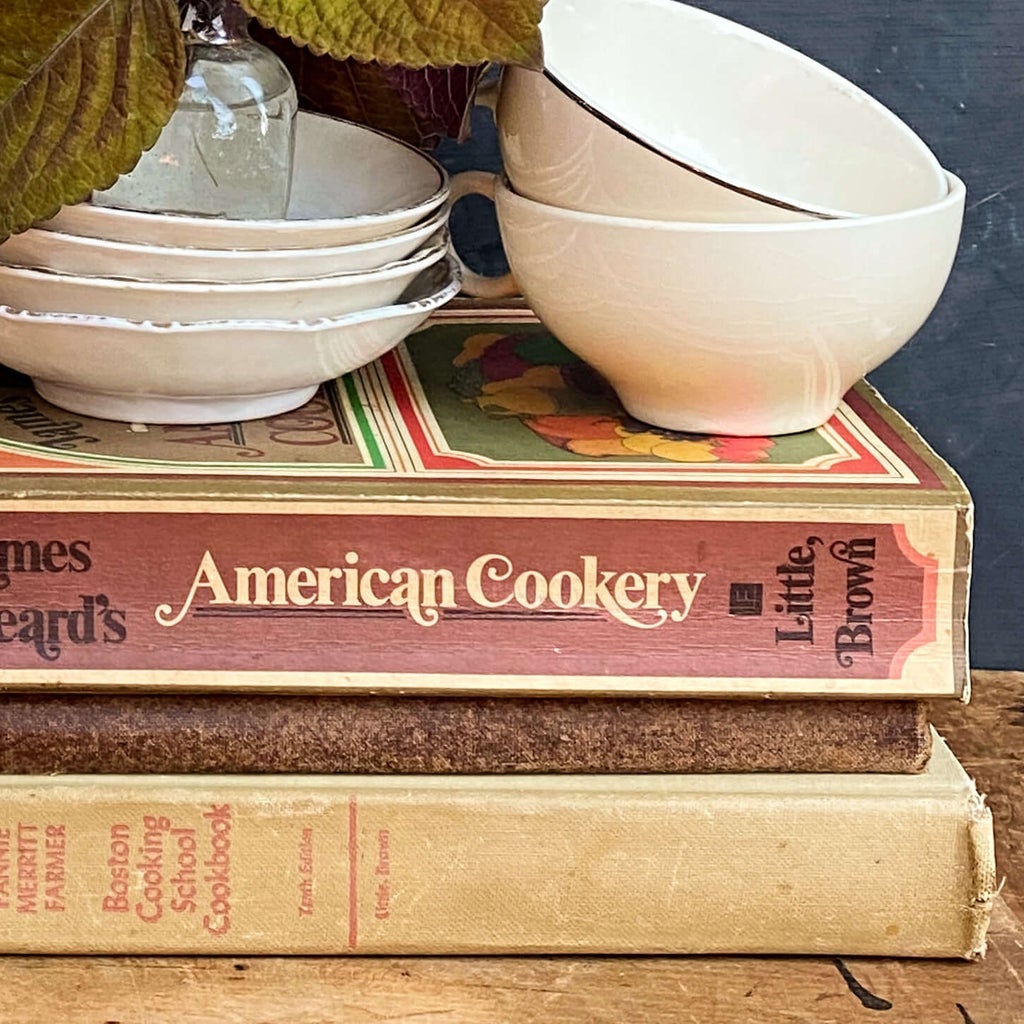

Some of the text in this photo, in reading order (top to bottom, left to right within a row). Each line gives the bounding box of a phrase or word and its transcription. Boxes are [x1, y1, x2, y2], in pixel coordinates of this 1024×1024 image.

[154, 550, 707, 629] American Cookery
[776, 535, 825, 646] Little,
[829, 536, 877, 669] Brown
[16, 821, 39, 915] MERRITT
[44, 823, 67, 913] FARMER
[102, 823, 130, 914] Boston
[135, 814, 172, 924] Cooking
[171, 827, 198, 914] School
[202, 802, 232, 936] Cookbook
